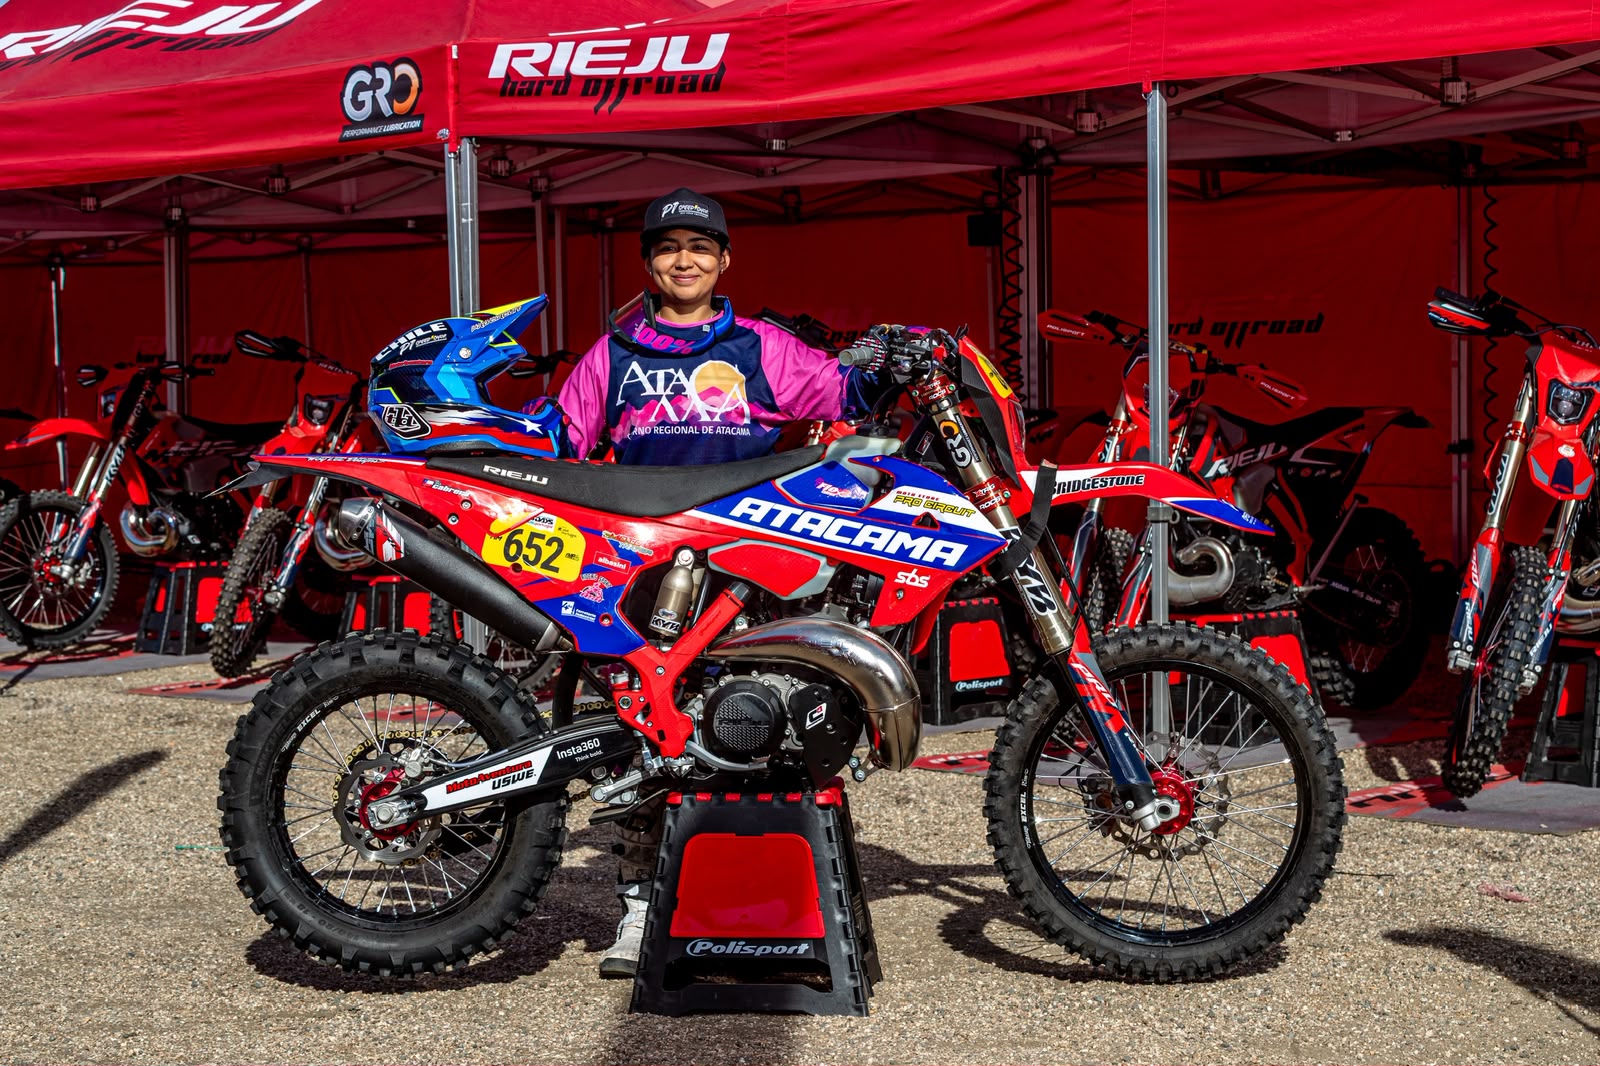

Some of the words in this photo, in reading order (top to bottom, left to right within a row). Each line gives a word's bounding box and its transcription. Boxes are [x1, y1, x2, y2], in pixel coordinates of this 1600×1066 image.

[488, 32, 730, 79] RIEJU
[342, 62, 420, 122] GRO
[501, 72, 572, 98] hard
[580, 61, 727, 115] offroad
[383, 119, 422, 132] LUBRICATION
[375, 321, 448, 362] CHILE
[1210, 313, 1325, 349] offroad
[653, 425, 700, 436] REGIONAL
[701, 425, 714, 434] DE
[715, 426, 751, 436] ATACAMA
[939, 419, 973, 468] GRO
[482, 465, 549, 485] RIEJU
[1203, 442, 1289, 479] RIEJU
[893, 495, 924, 507] PRO
[923, 500, 976, 518] CIRCUIT
[729, 497, 969, 567] ATACAMA
[503, 528, 564, 573] 652
[597, 556, 627, 569] albasini
[894, 568, 931, 588] sbs
[955, 678, 1004, 693] Polisport
[1071, 662, 1119, 709] PRO
[296, 708, 321, 732] EXCEL
[556, 737, 601, 760] Insta360
[446, 760, 533, 794] MotoAventura
[1019, 791, 1028, 823] EXCEL
[686, 938, 810, 957] Polisport
